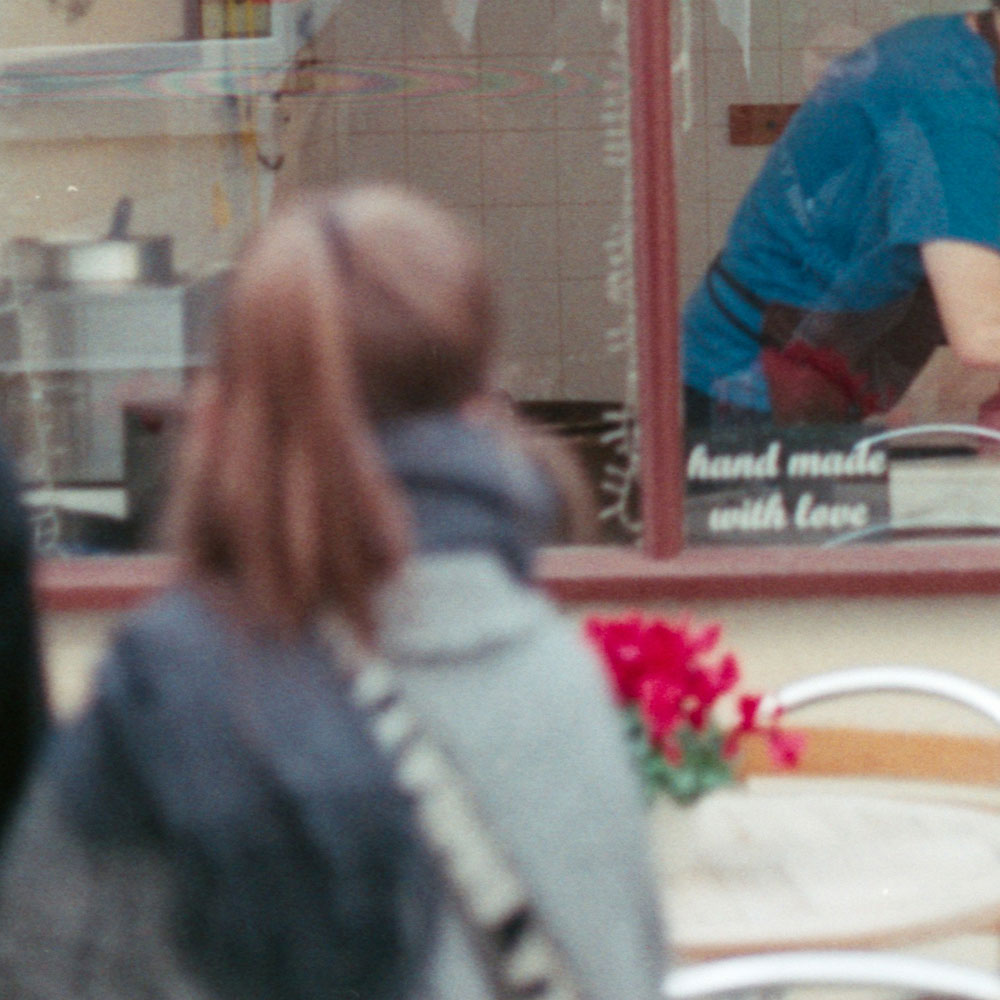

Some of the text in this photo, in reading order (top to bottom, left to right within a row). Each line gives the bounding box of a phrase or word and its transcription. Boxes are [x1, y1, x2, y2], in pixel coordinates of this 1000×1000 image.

[687, 441, 887, 480] hand made
[708, 492, 869, 532] with love
